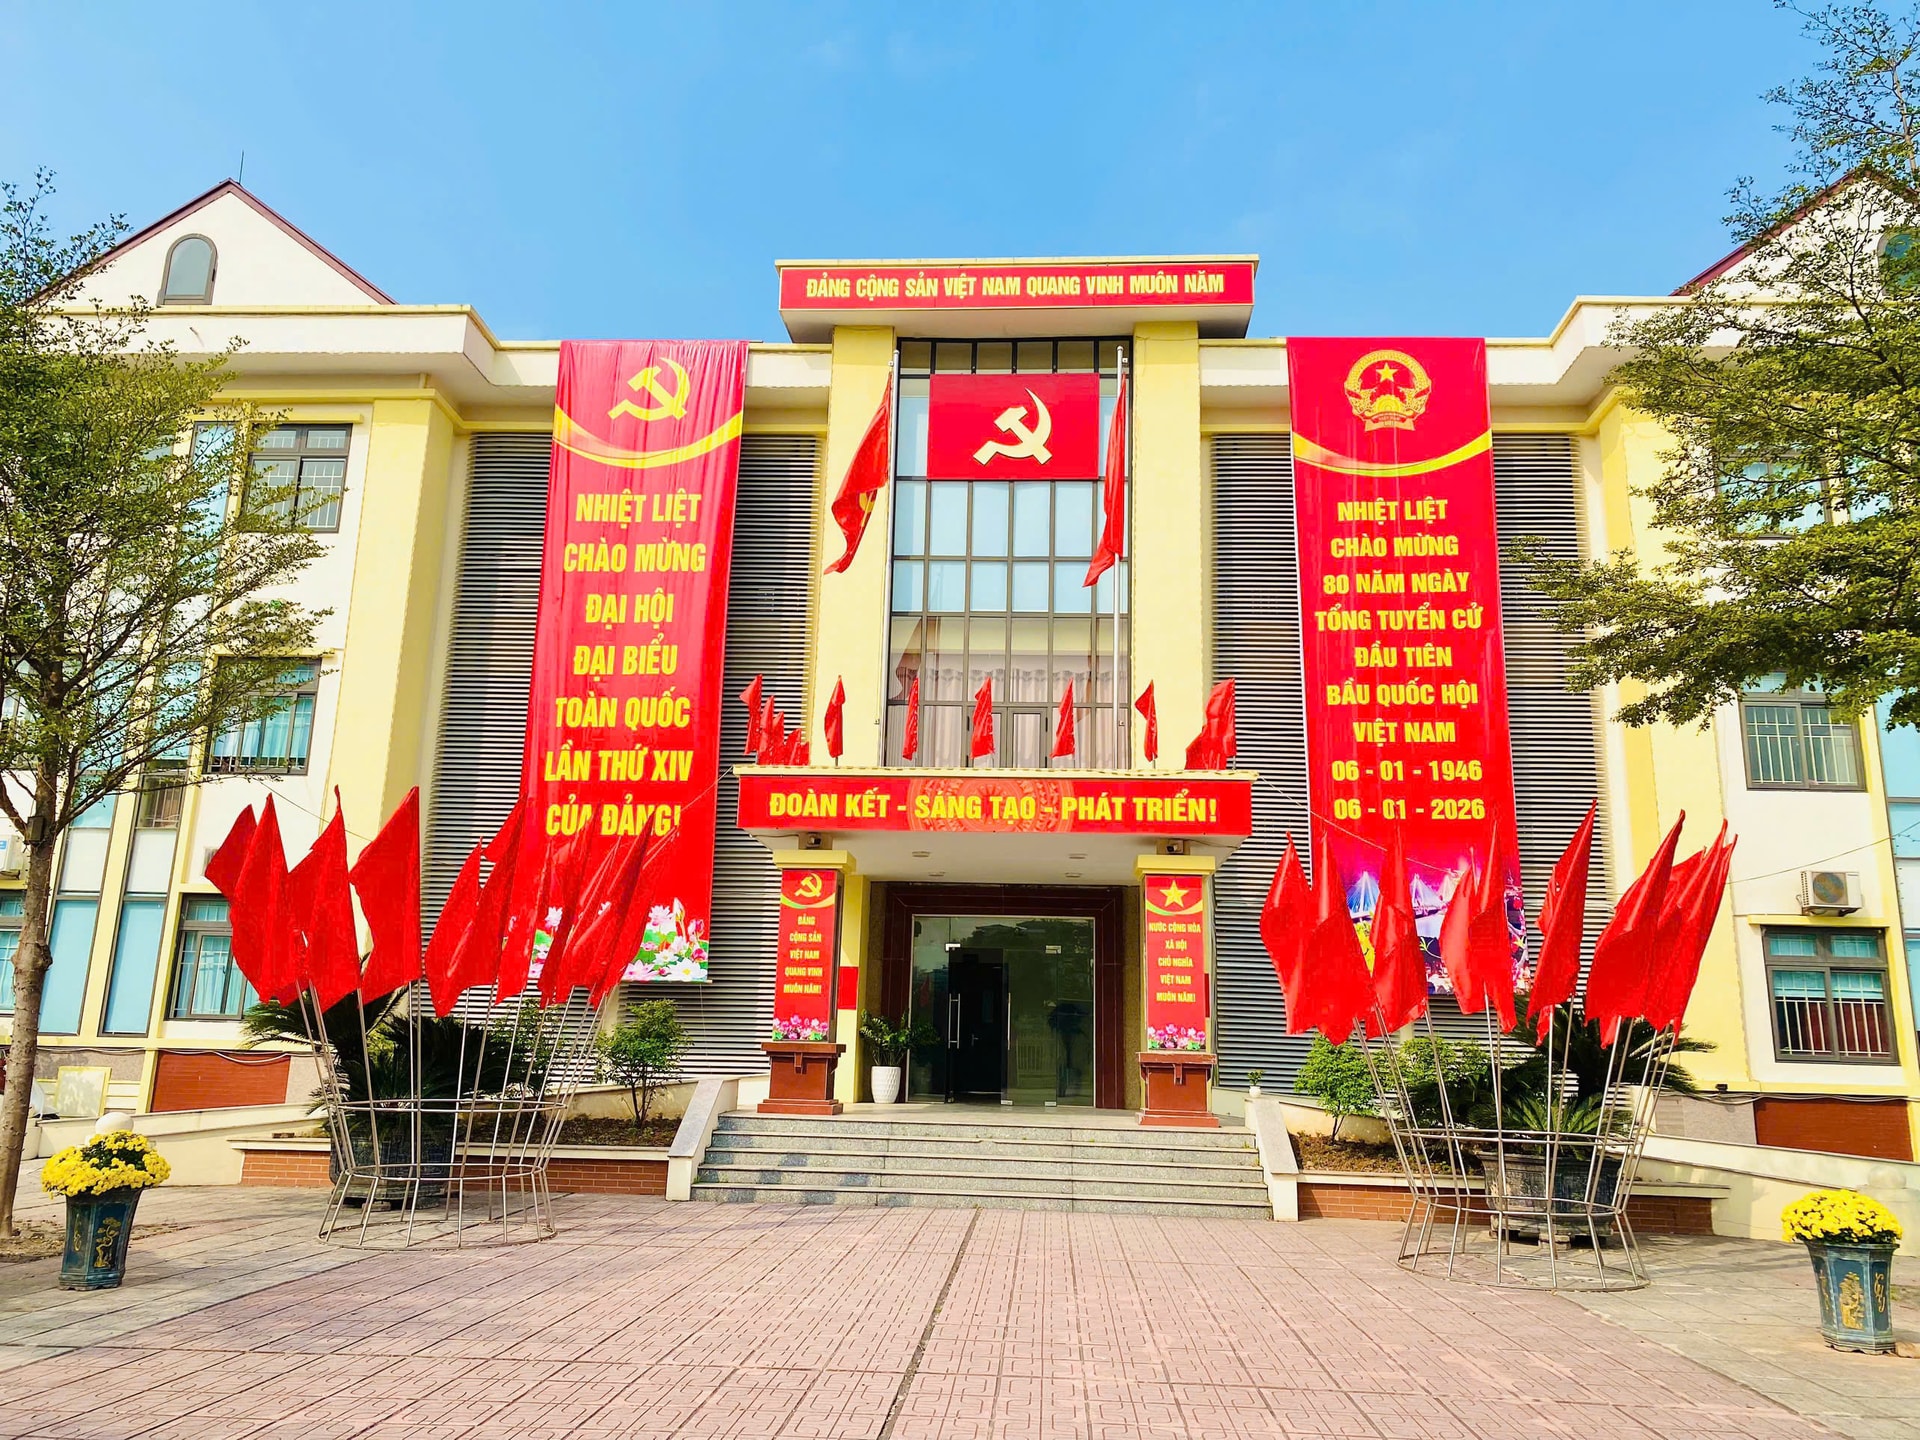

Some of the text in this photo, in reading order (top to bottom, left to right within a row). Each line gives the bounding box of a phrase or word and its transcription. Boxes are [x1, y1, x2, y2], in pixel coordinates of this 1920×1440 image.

[806, 271, 1224, 300] ĐẢNG CỘNG SẢN VIỆT NAM QUANG VINH MUÔN NĂM
[575, 488, 701, 529] NHIỆT LIỆT
[1338, 496, 1447, 524] NHIỆT LIỆT
[564, 537, 706, 573] CHÀO MỪNG
[1331, 533, 1458, 558] CHÀO MỪNG
[1323, 569, 1469, 594] 80 NĂM NGÀY
[585, 587, 675, 630] ĐẠI HỘI
[1315, 602, 1483, 631] TỔNG TUYỂN CỬ
[574, 633, 678, 681] ĐẠI BIỂU
[1354, 641, 1452, 667] ĐẦU TIÊN
[1327, 678, 1478, 708] BẦU QUỐC HỘI
[555, 686, 690, 731] TOÀN QUỐC
[1353, 718, 1455, 747] VIỆT NAM
[545, 740, 693, 781] LẦN THỨ XIV
[1332, 760, 1359, 781] 06
[1380, 761, 1403, 780] 01
[1429, 760, 1482, 780] 1946
[770, 789, 837, 817] ĐOÀN
[846, 788, 890, 817] KẾT
[913, 789, 983, 820] SÁNG
[990, 796, 1036, 826] TẠO
[1061, 792, 1125, 821] PHÁT
[1133, 789, 1216, 822] TRIỂN!
[1334, 799, 1361, 819] 06
[1383, 799, 1405, 819] 01
[1431, 799, 1485, 819] 2026
